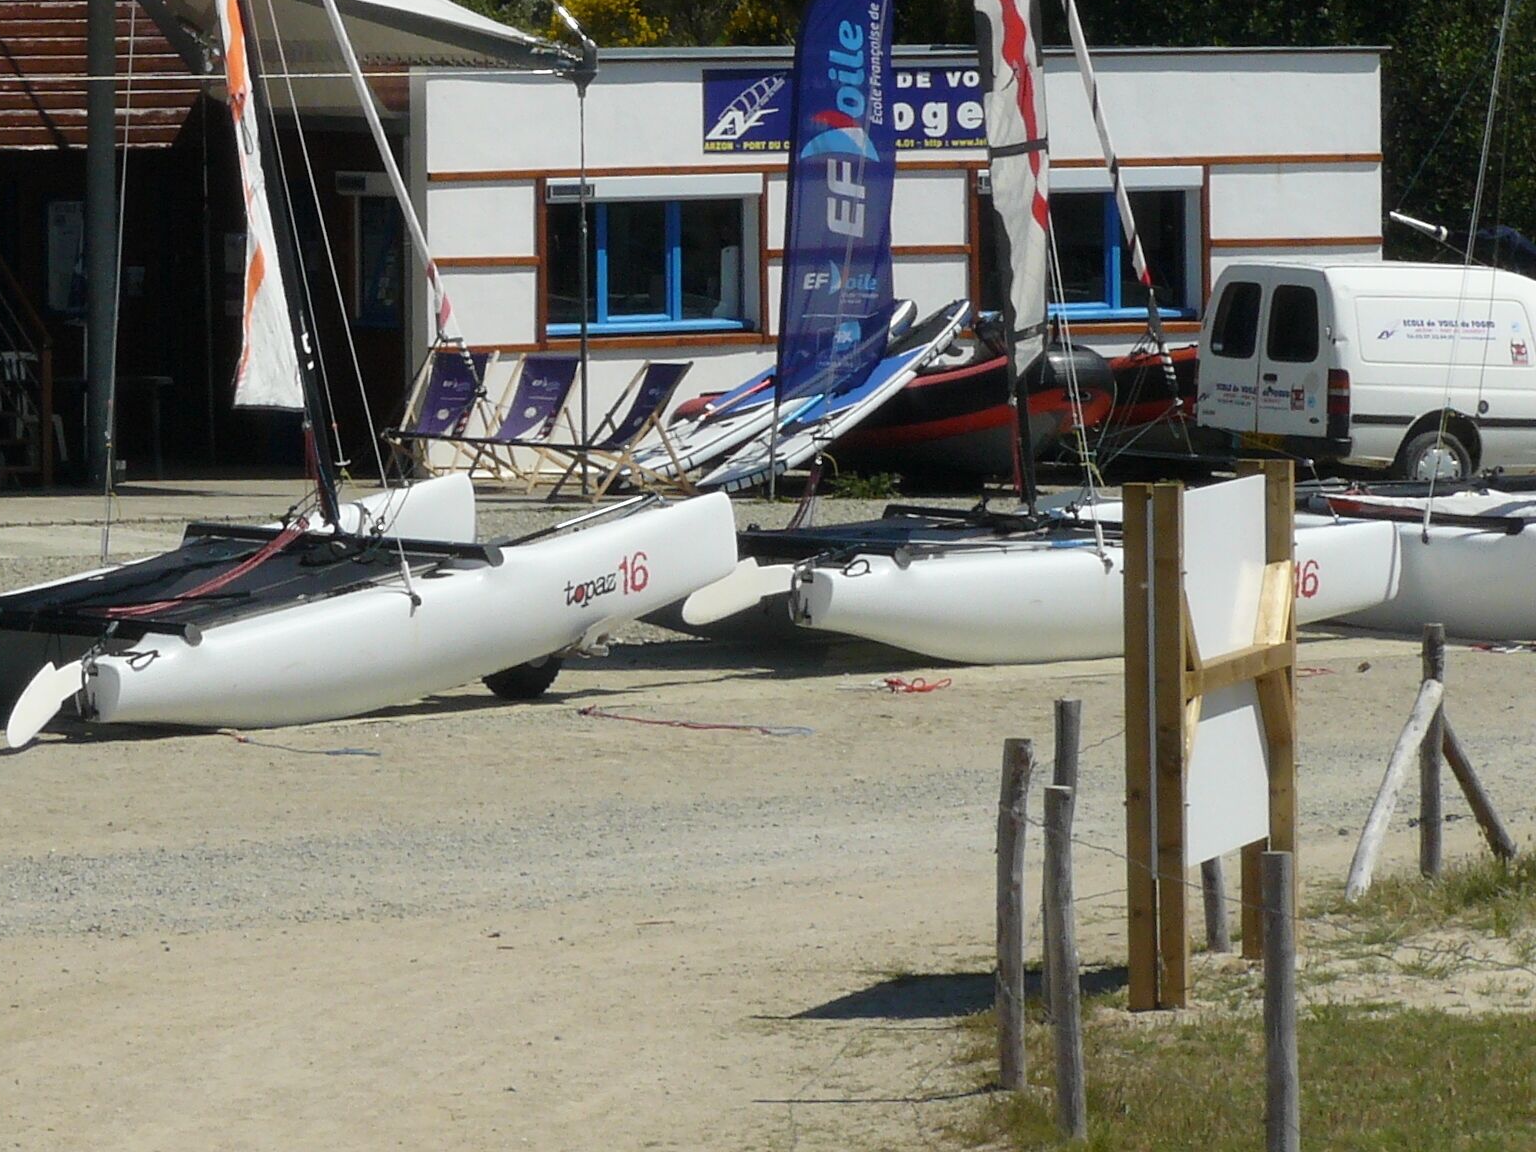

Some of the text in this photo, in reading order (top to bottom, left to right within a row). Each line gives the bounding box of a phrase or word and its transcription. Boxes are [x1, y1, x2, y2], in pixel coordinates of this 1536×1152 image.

[867, 4, 880, 20] de
[896, 71, 931, 88] DE
[564, 551, 649, 608] topaz 16
[1294, 559, 1320, 599] 16
